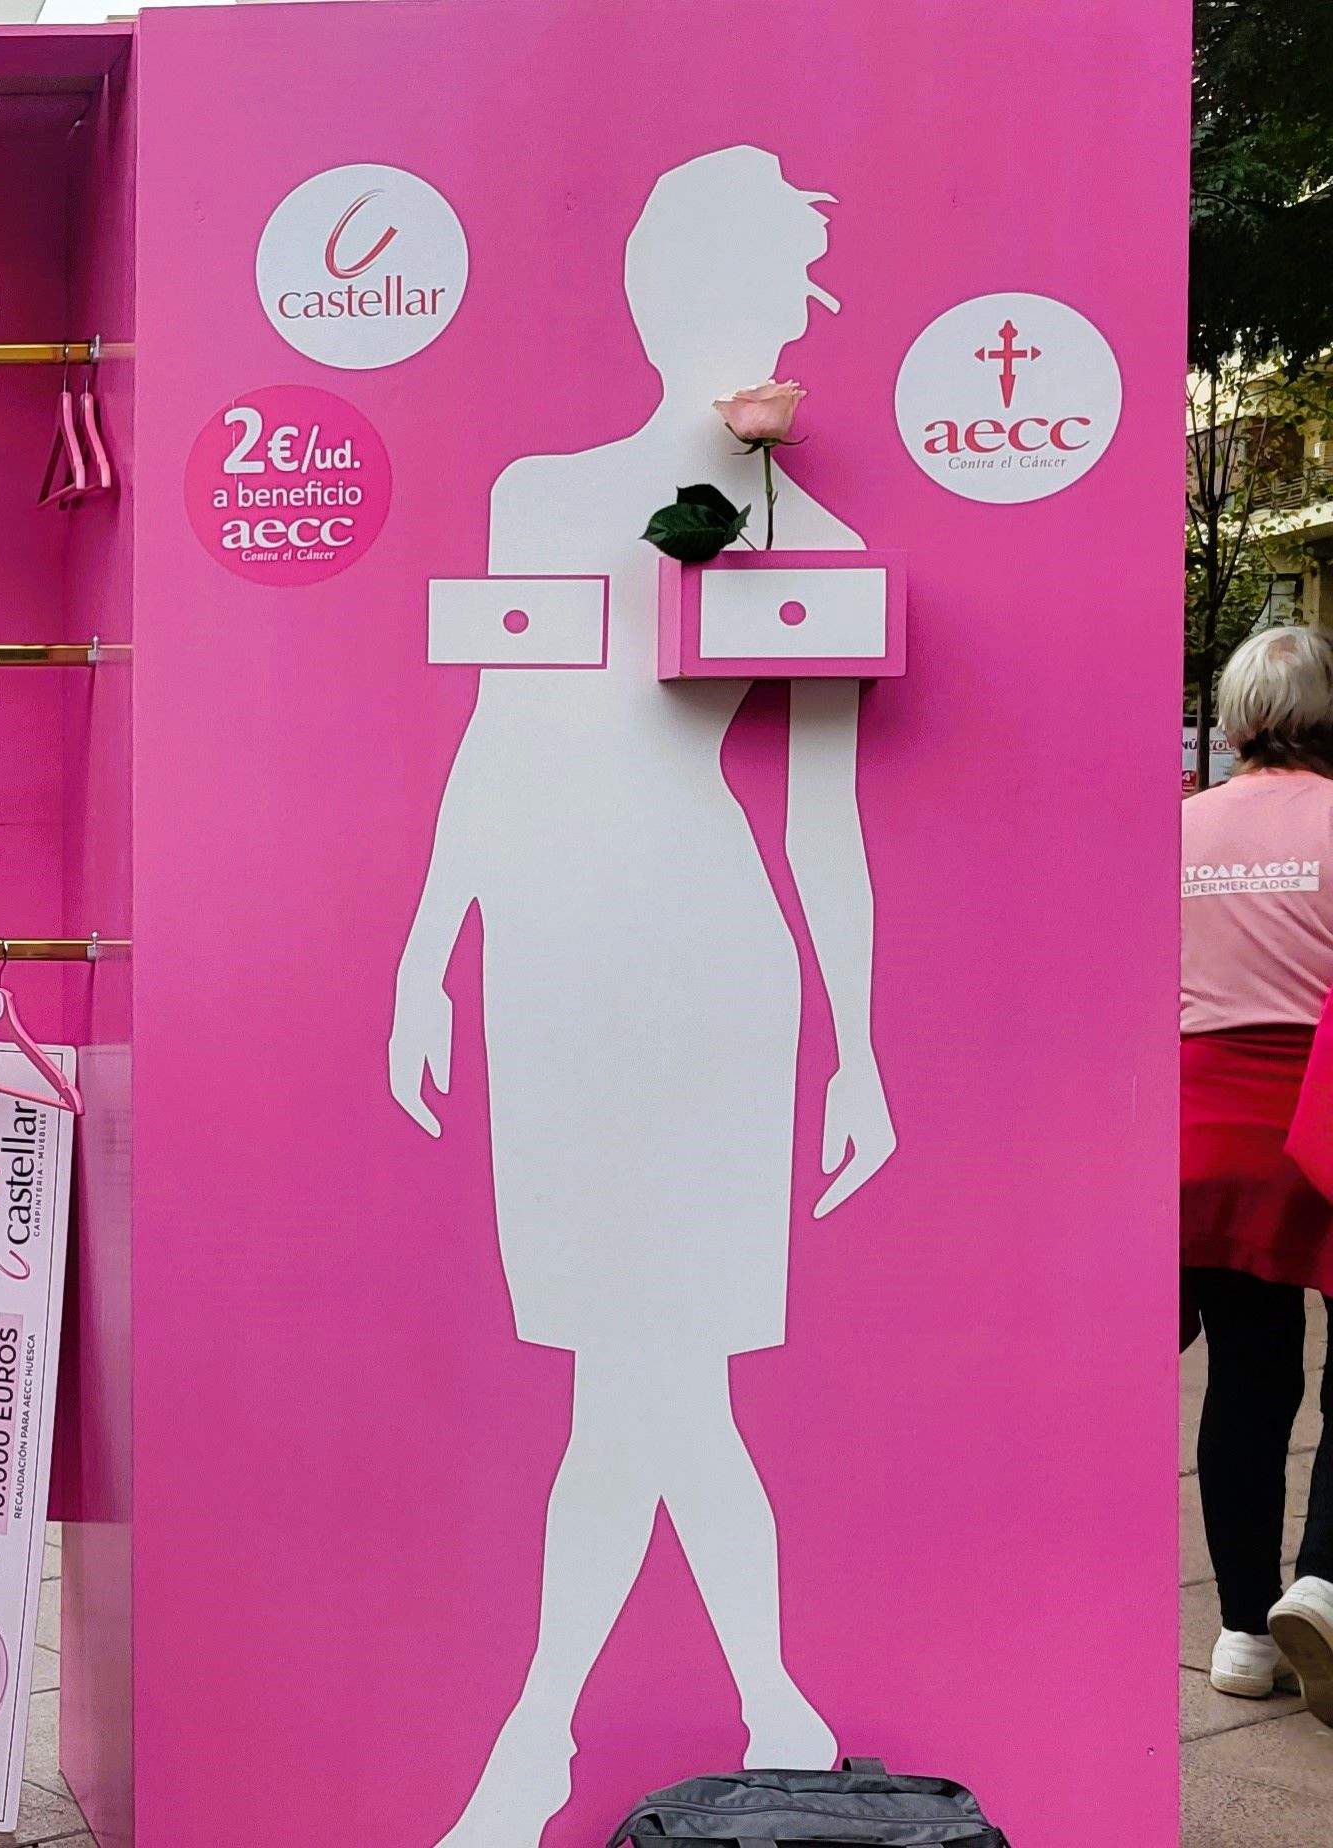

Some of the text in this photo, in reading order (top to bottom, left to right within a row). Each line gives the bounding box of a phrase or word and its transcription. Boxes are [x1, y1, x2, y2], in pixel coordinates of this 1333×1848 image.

[278, 275, 445, 319] castellar
[223, 407, 361, 474] 2€/ud.
[924, 416, 1091, 454] aecc
[948, 455, 1068, 470] Contra el Cáncer
[213, 481, 362, 508] a beneficio
[222, 517, 354, 549] aecc
[241, 550, 278, 562] Contra
[283, 550, 292, 561] el
[1183, 857, 1320, 881] TOARAGÓN
[1182, 879, 1301, 895] UPERMERCADOS
[37, 1113, 47, 1160] MUEBLES
[1, 1100, 37, 1245] castellar
[27, 1334, 36, 1377] HUESCA
[20, 1410, 31, 1439] PARA
[13, 1441, 28, 1519] RECAUDACIÓN
